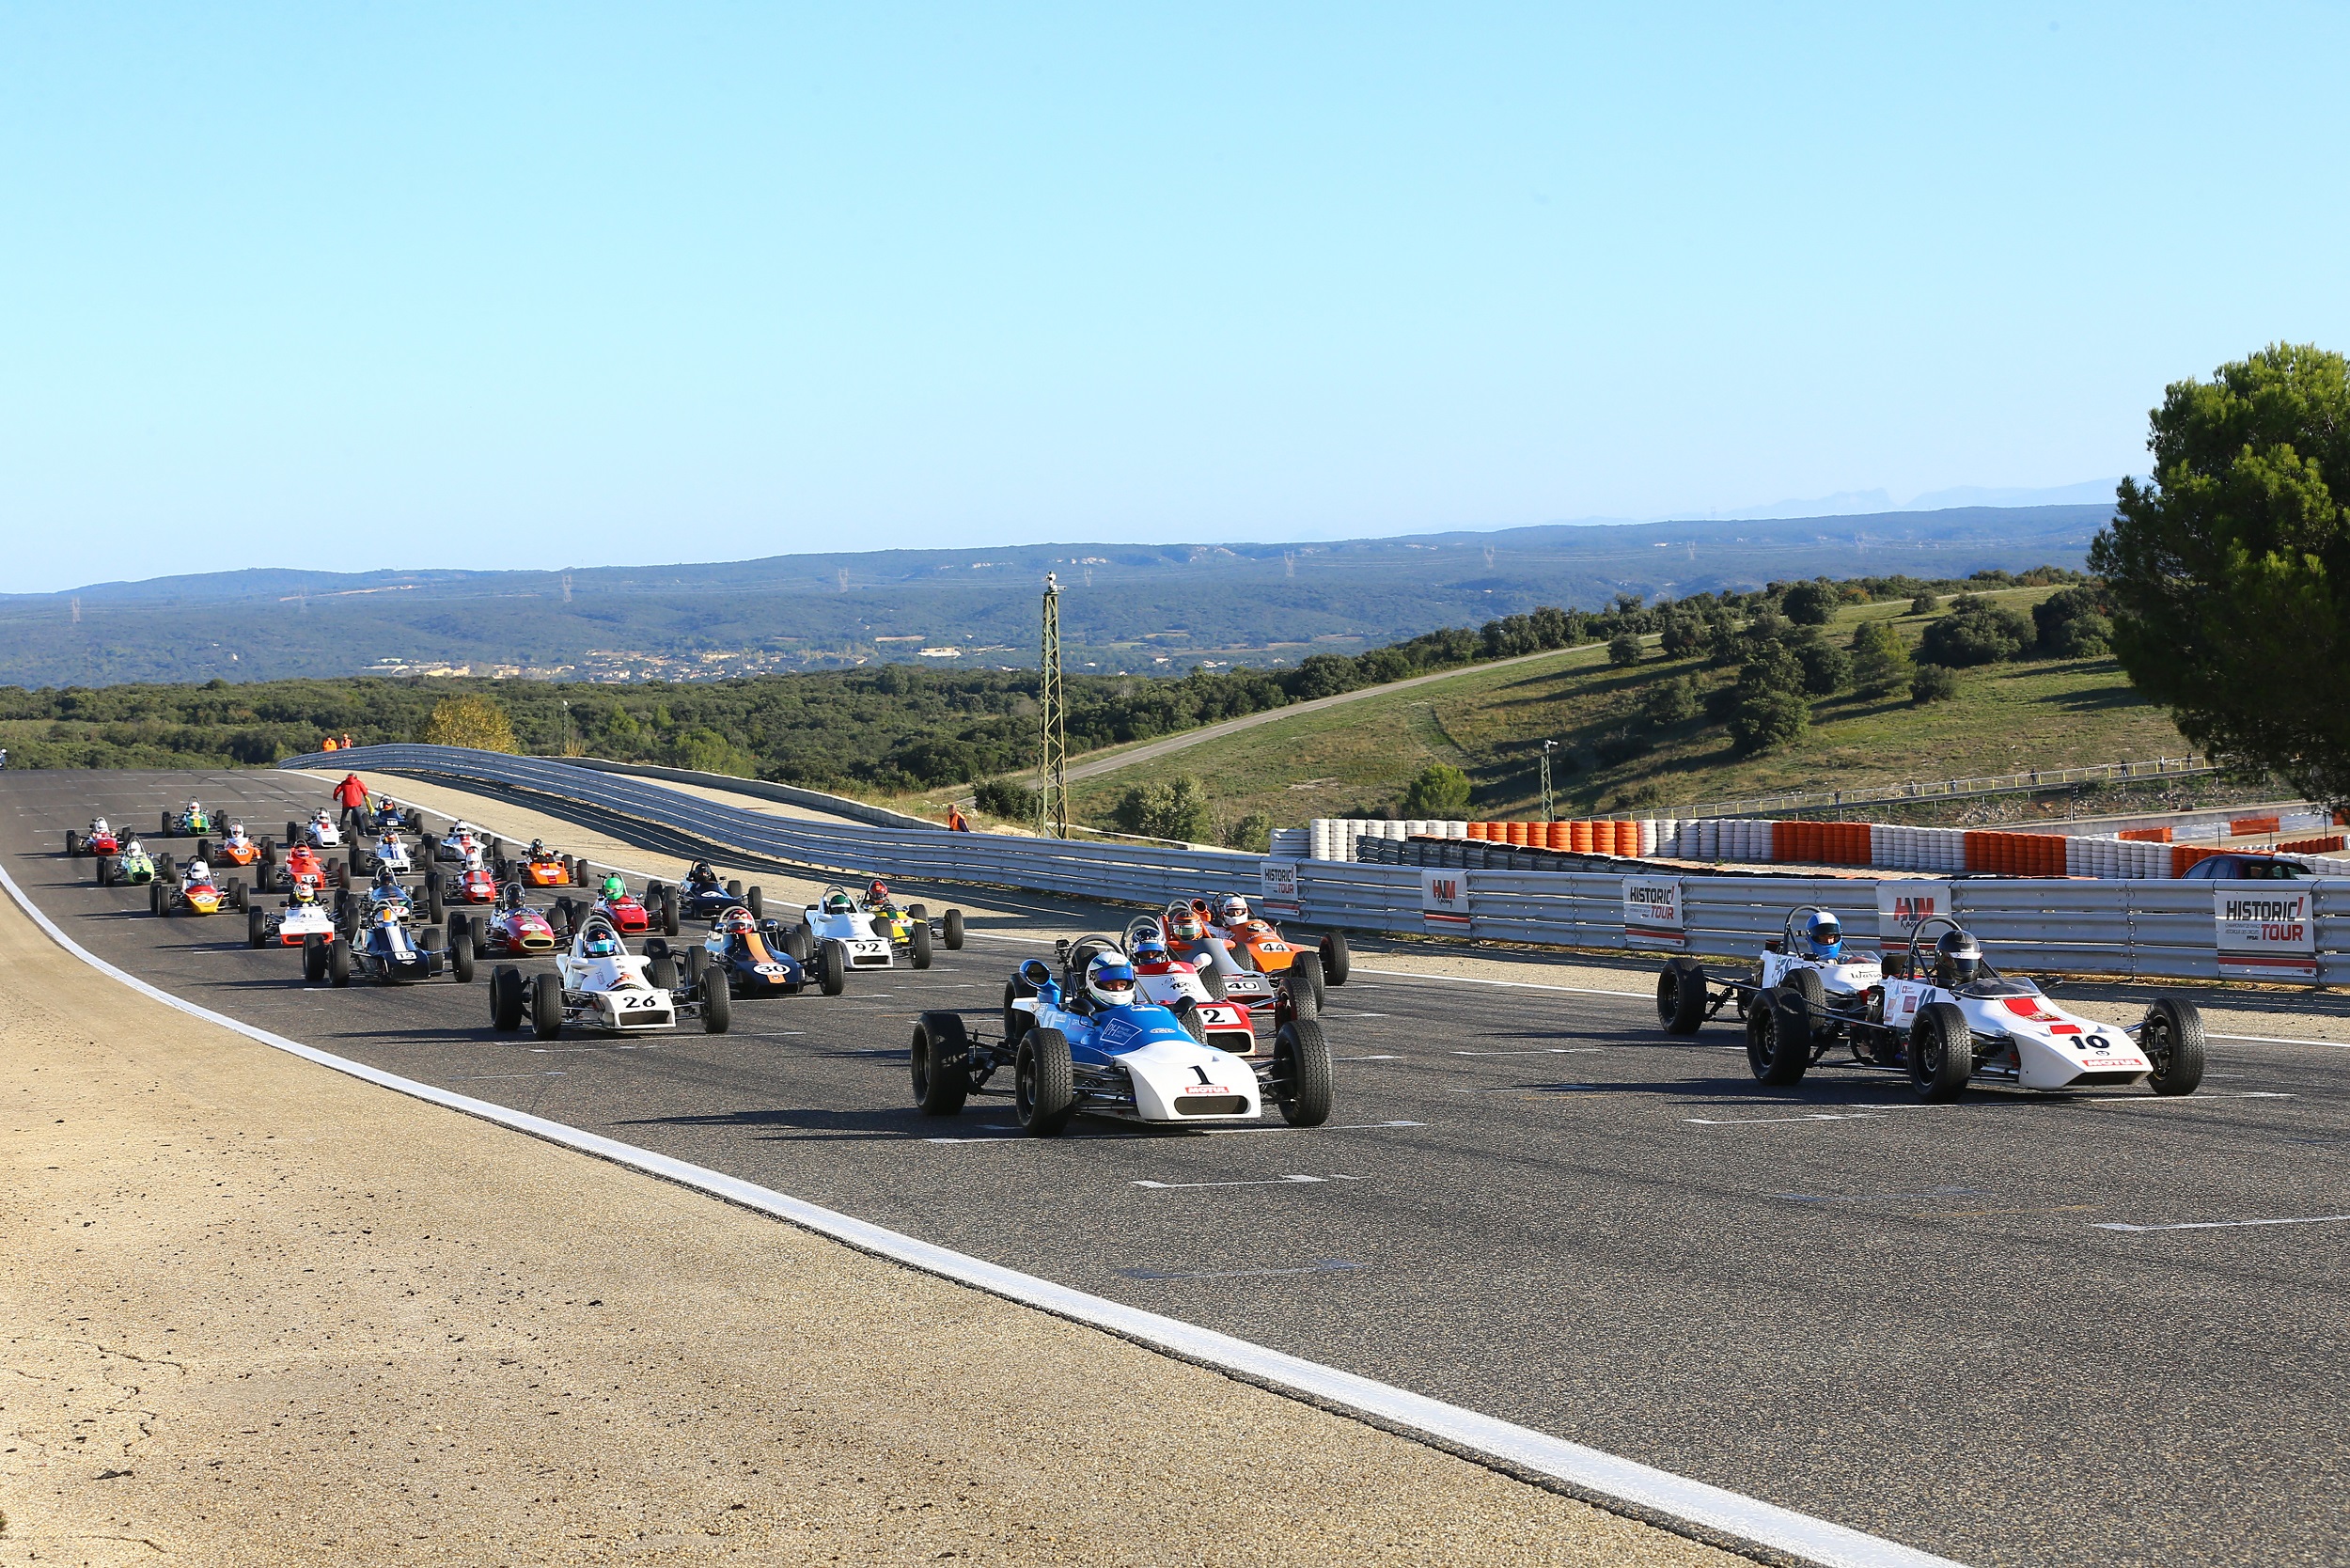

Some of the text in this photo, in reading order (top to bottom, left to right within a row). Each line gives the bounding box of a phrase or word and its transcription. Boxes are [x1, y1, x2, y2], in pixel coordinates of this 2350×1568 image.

[1278, 884, 1294, 894] TOUR
[1651, 905, 1675, 920] TOUR
[2261, 924, 2304, 941] TOUR
[855, 943, 882, 952] 92
[1263, 943, 1286, 951] 44
[622, 996, 656, 1008] 26
[1202, 1009, 1226, 1023] 2
[2070, 1035, 2110, 1049] 10
[1187, 1065, 1214, 1085] 1
